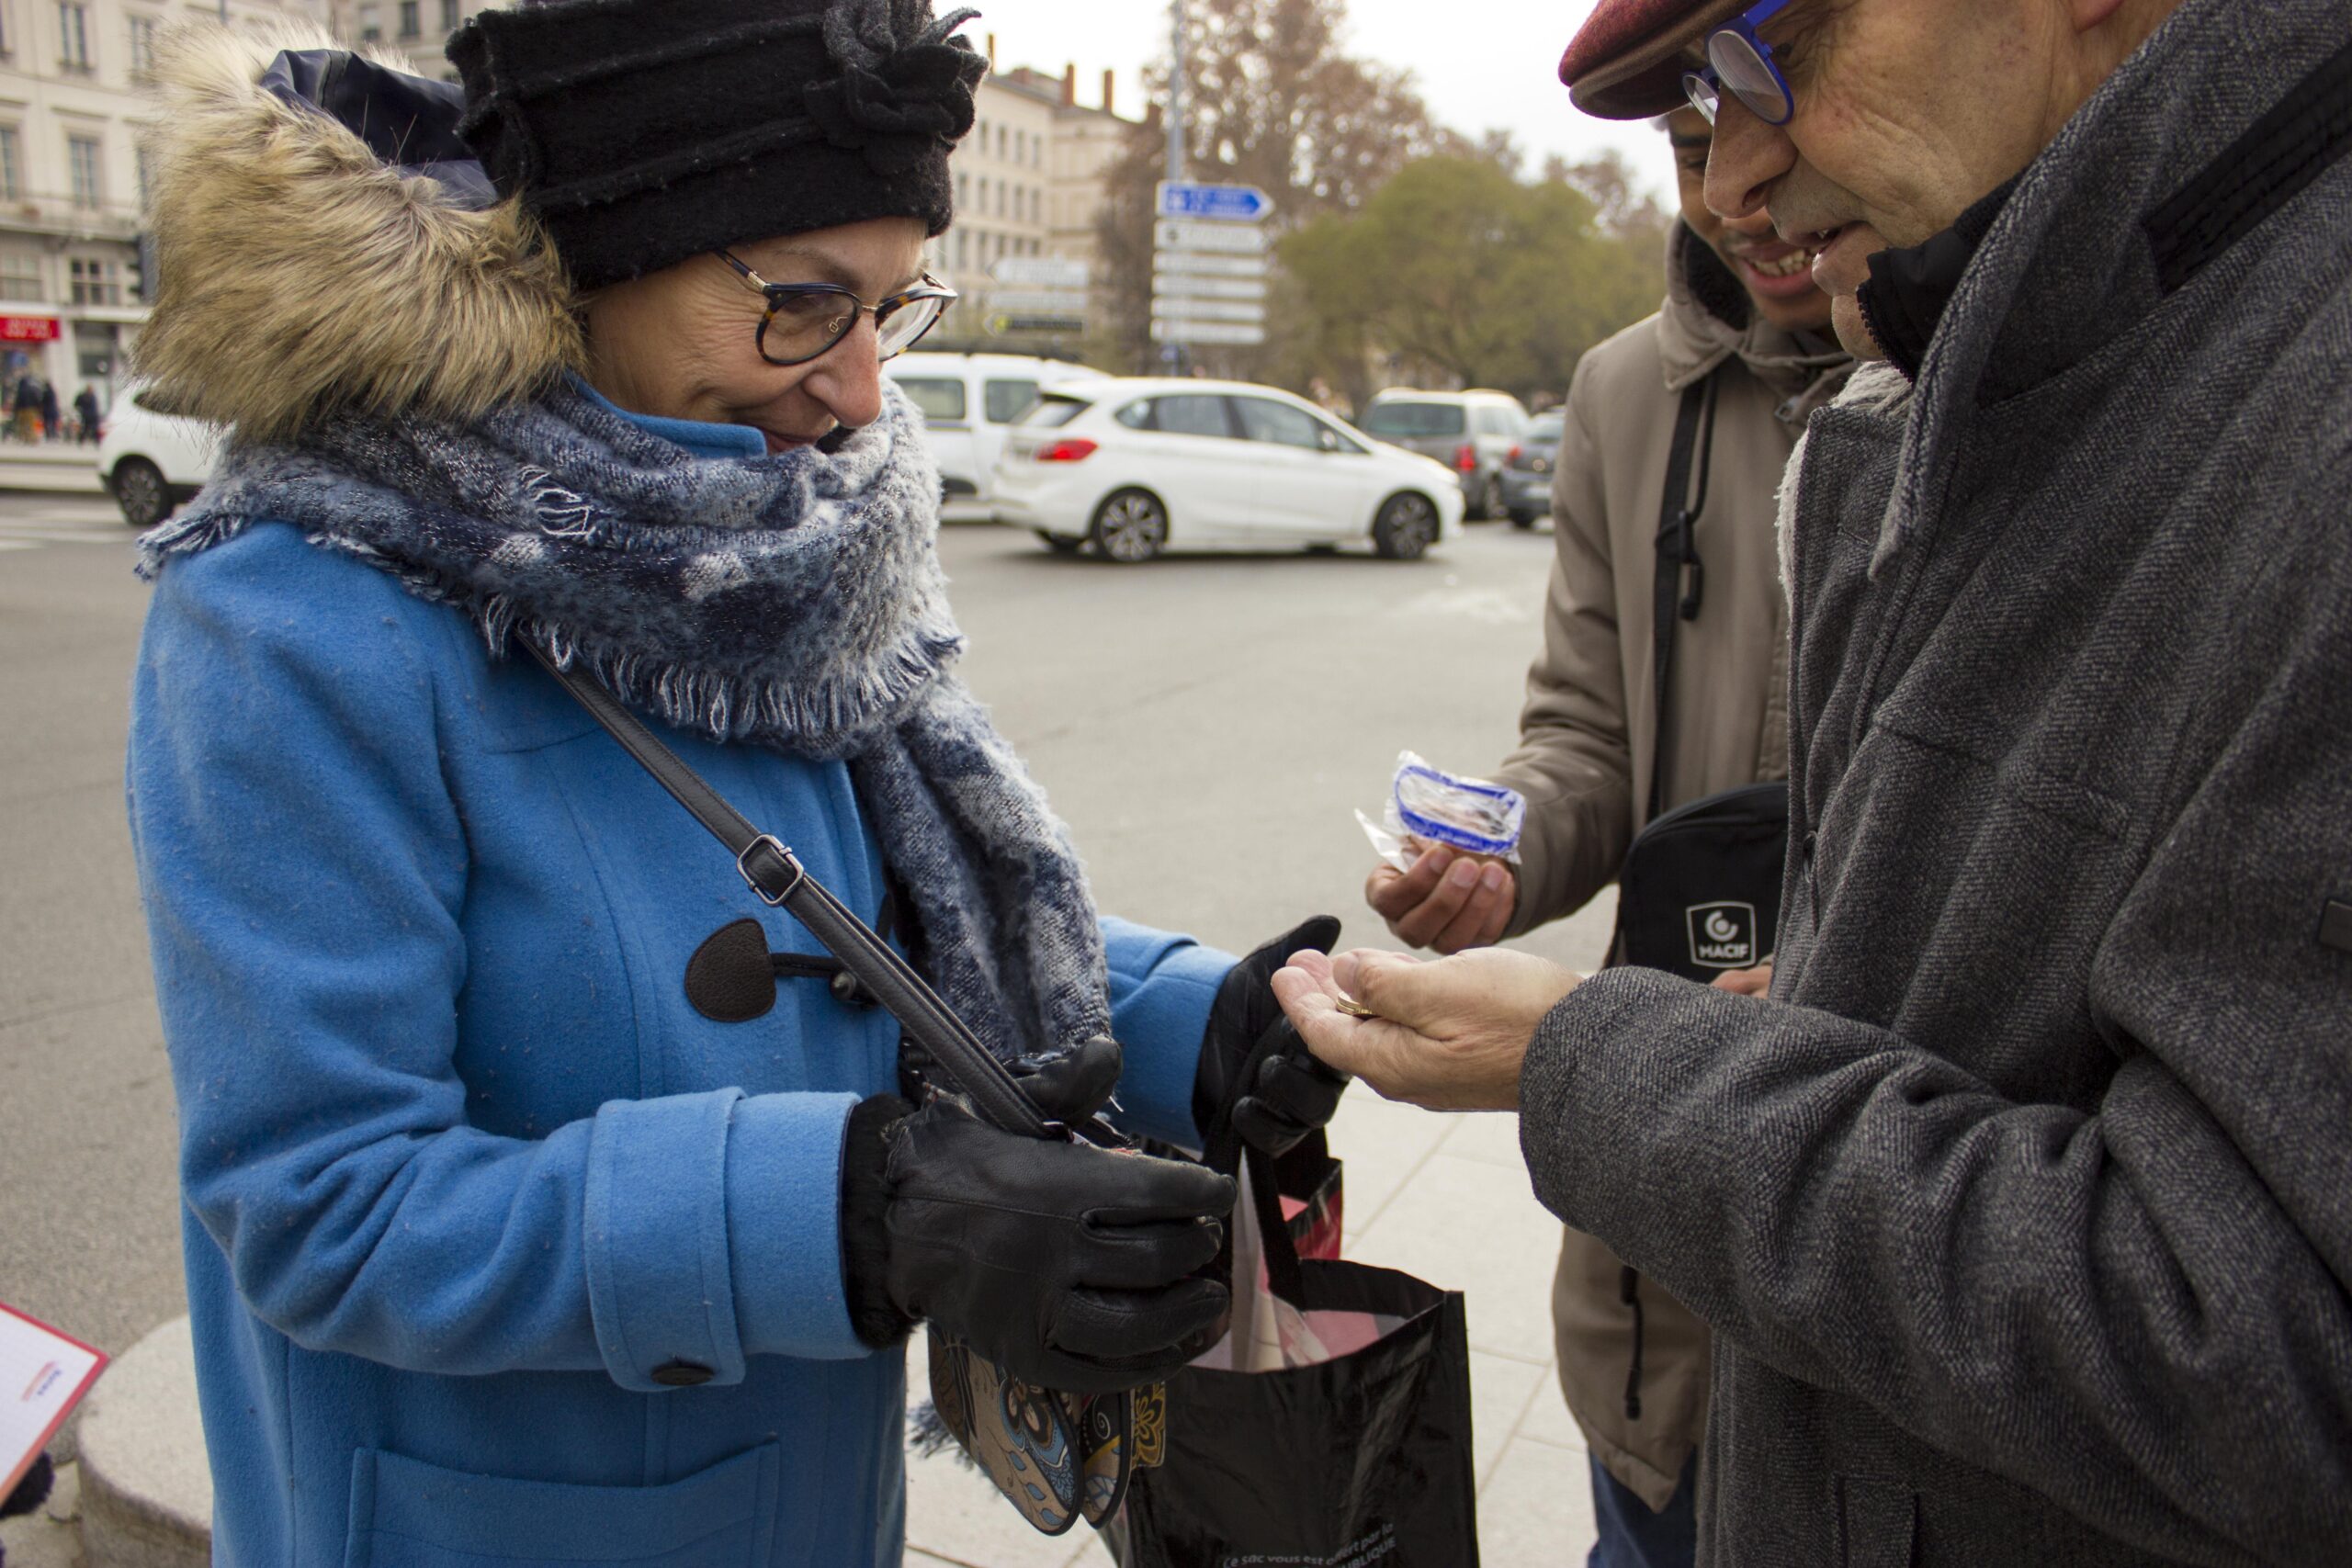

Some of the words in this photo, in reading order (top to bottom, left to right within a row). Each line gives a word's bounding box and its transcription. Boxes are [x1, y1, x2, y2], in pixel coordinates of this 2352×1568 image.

[1698, 943, 1748, 958] MACIF
[1240, 1554, 1264, 1565] sac
[1267, 1555, 1300, 1564] vous
[1303, 1555, 1322, 1565] est
[1361, 1529, 1381, 1551] par
